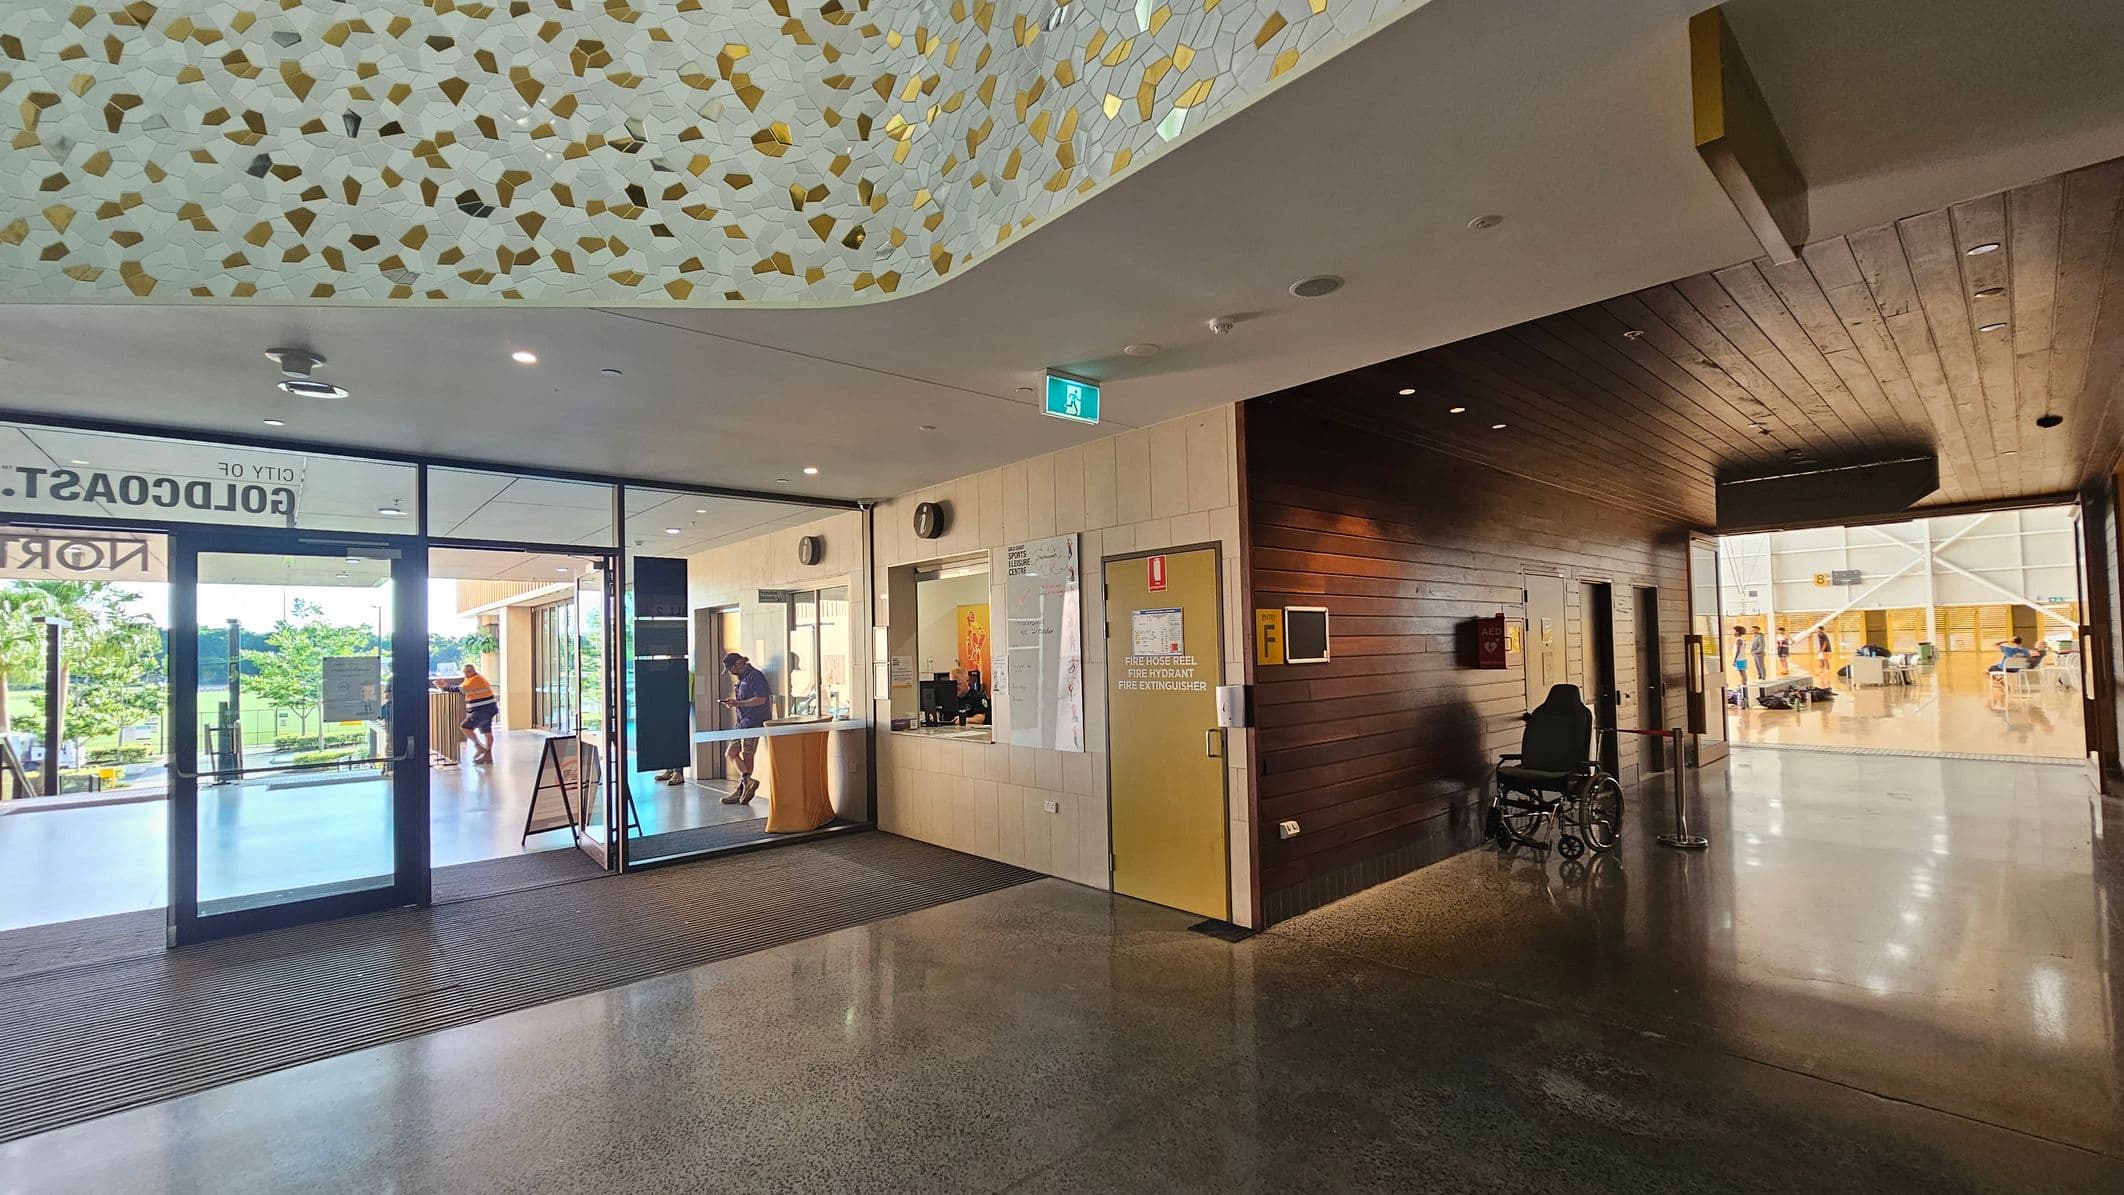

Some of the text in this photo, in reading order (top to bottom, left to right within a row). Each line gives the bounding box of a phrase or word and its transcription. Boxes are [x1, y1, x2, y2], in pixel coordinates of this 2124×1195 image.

[1008, 550, 1027, 560] SPORTS
[1008, 567, 1027, 576] CENTRE
[1481, 627, 1502, 636] AED
[1263, 624, 1276, 658] F
[1125, 656, 1197, 666] FIRE HOSE REEL
[1128, 668, 1194, 678] FIRE HYDRANT
[1118, 681, 1207, 691] FIRE EXTINGUISHER
